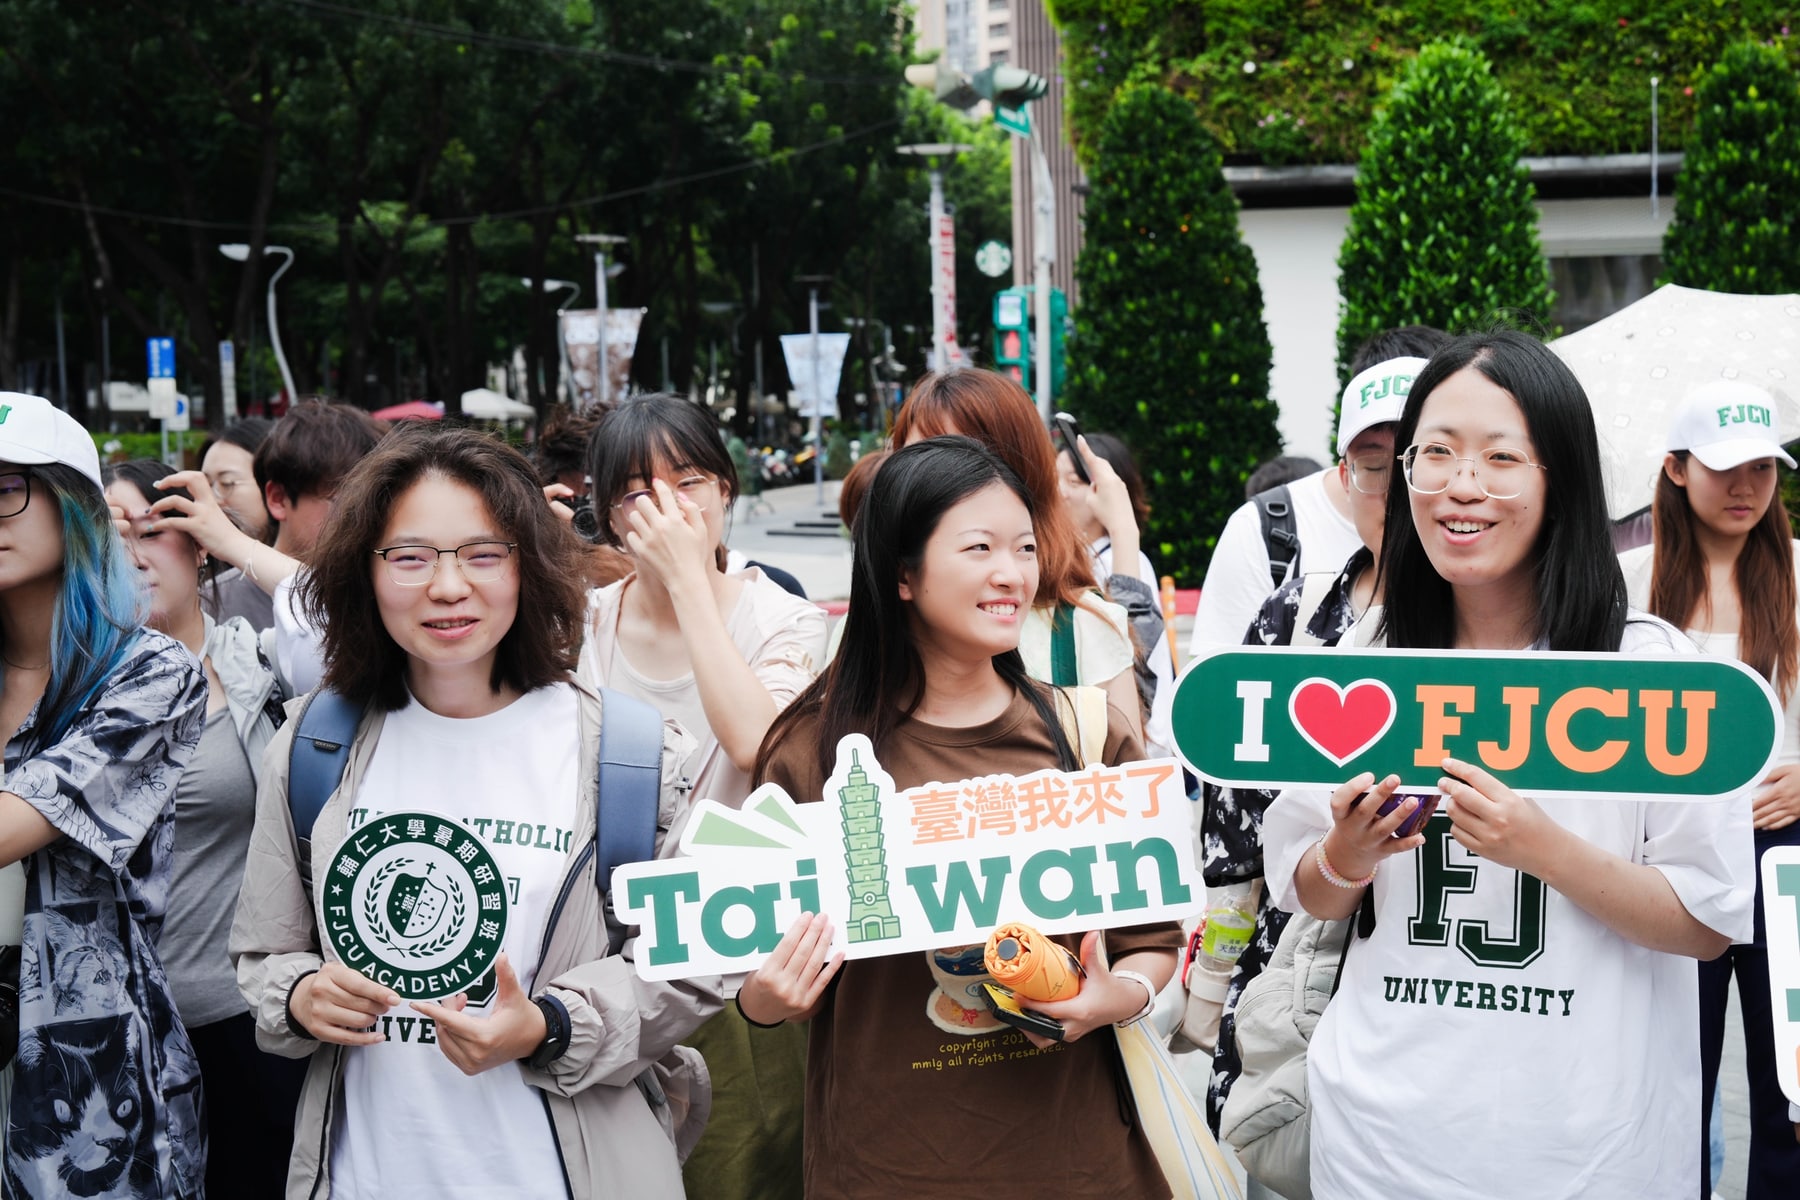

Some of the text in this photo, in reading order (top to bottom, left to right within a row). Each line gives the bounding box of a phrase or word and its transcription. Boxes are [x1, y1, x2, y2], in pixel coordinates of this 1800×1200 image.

[1360, 374, 1416, 409] FJC
[1717, 404, 1770, 427] FJCU
[1233, 680, 1716, 776] I FJCU
[909, 764, 1175, 845] 臺灣我來了
[336, 818, 502, 942] 輔仁大學暑期研習班
[329, 905, 473, 993] FJCU ACADEMY
[1383, 976, 1575, 1016] UNIVERSITY
[939, 1038, 996, 1054] copyright
[948, 1055, 963, 1067] all
[968, 1052, 1005, 1066] rights
